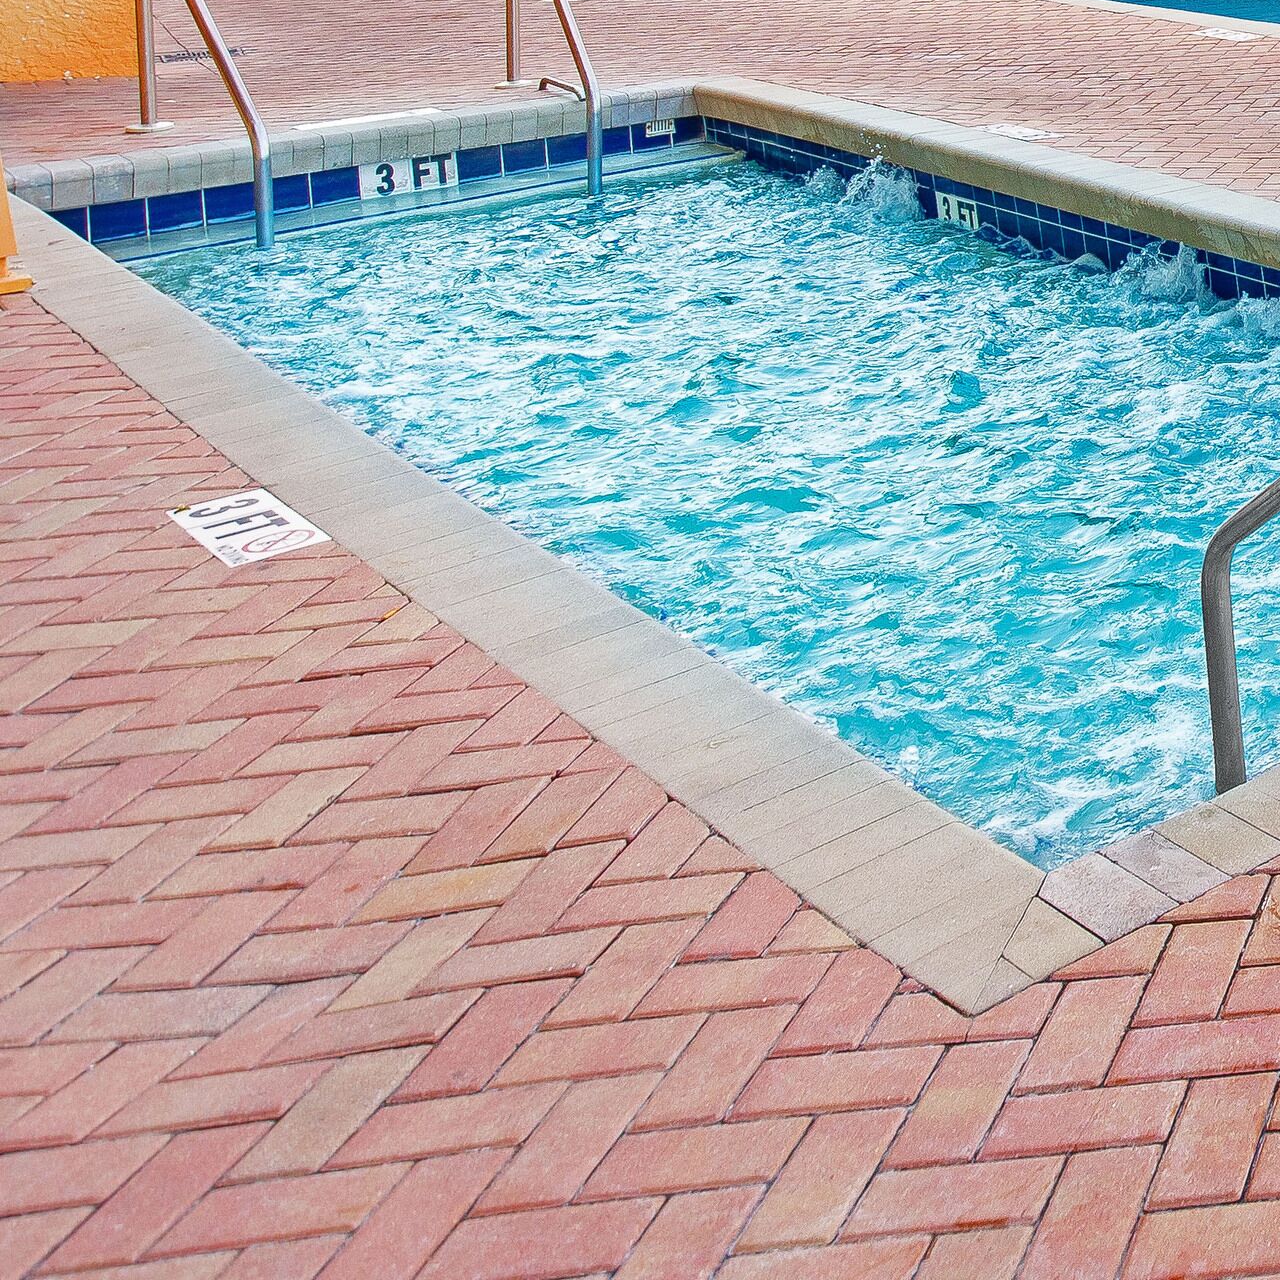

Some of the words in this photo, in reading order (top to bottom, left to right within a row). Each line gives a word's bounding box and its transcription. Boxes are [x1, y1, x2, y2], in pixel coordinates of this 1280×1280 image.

[375, 163, 396, 196] 3
[411, 152, 453, 190] FT
[942, 196, 952, 221] 3
[956, 200, 976, 230] FT
[188, 498, 260, 518] 3
[202, 509, 291, 540] FT
